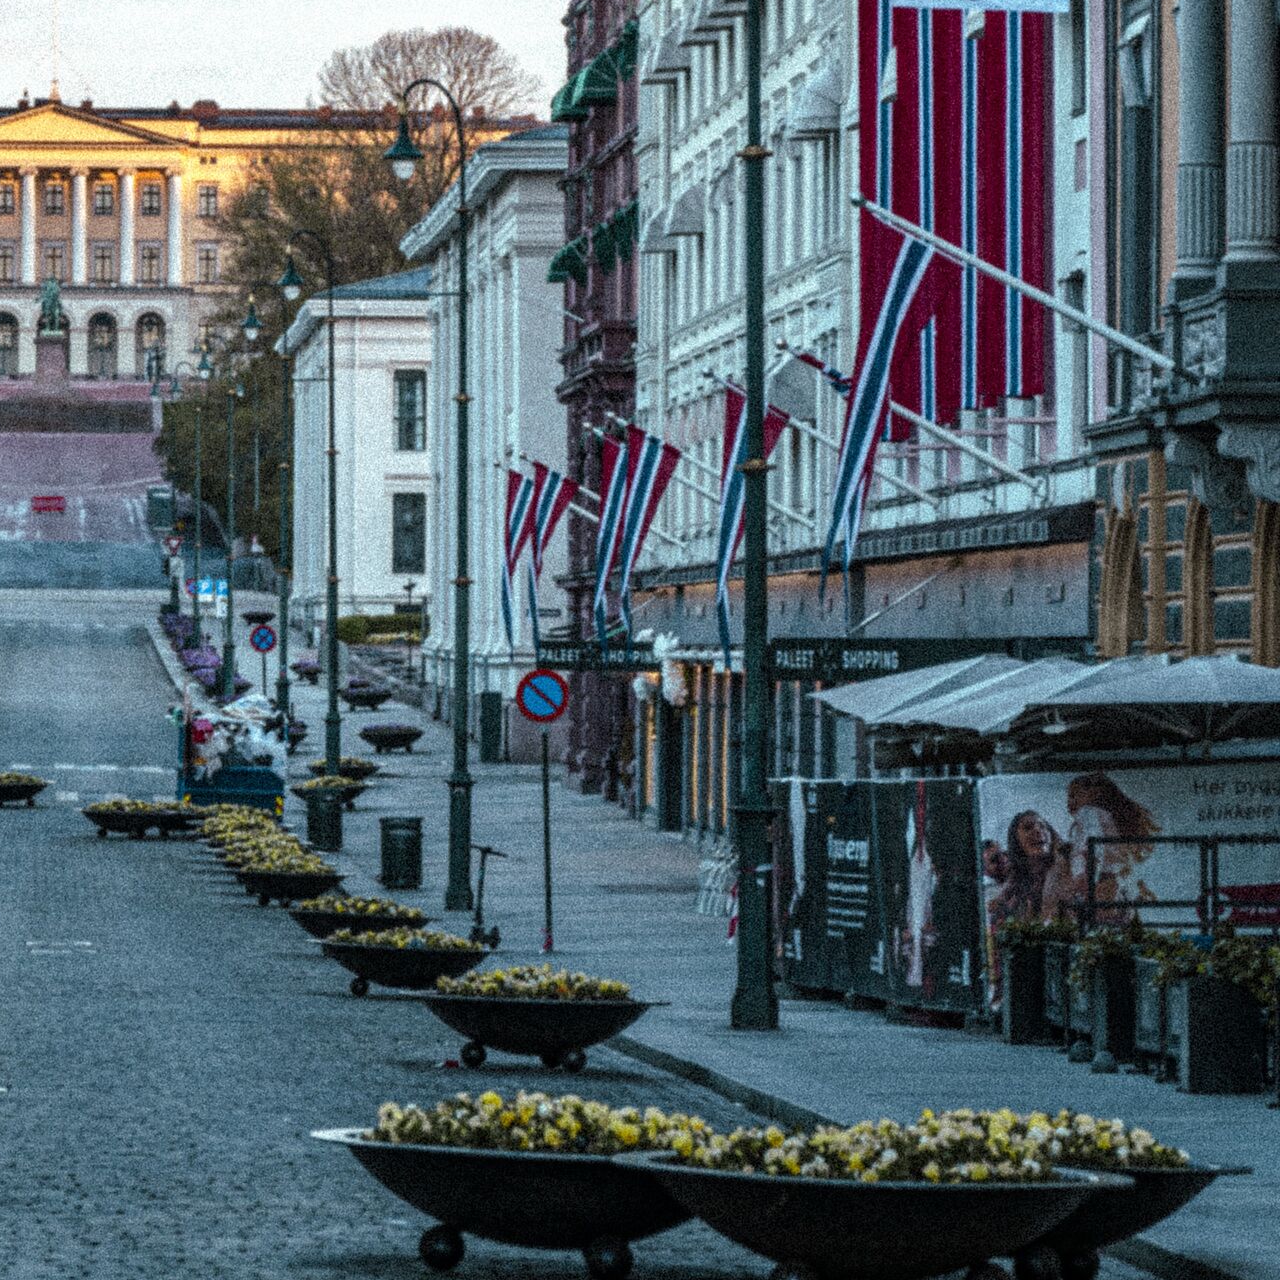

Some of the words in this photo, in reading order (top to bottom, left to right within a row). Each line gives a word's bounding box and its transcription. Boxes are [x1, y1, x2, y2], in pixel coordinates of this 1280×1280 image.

[538, 647, 581, 662] PALEET
[775, 649, 814, 669] PALEET
[842, 649, 900, 669] SHOPPING
